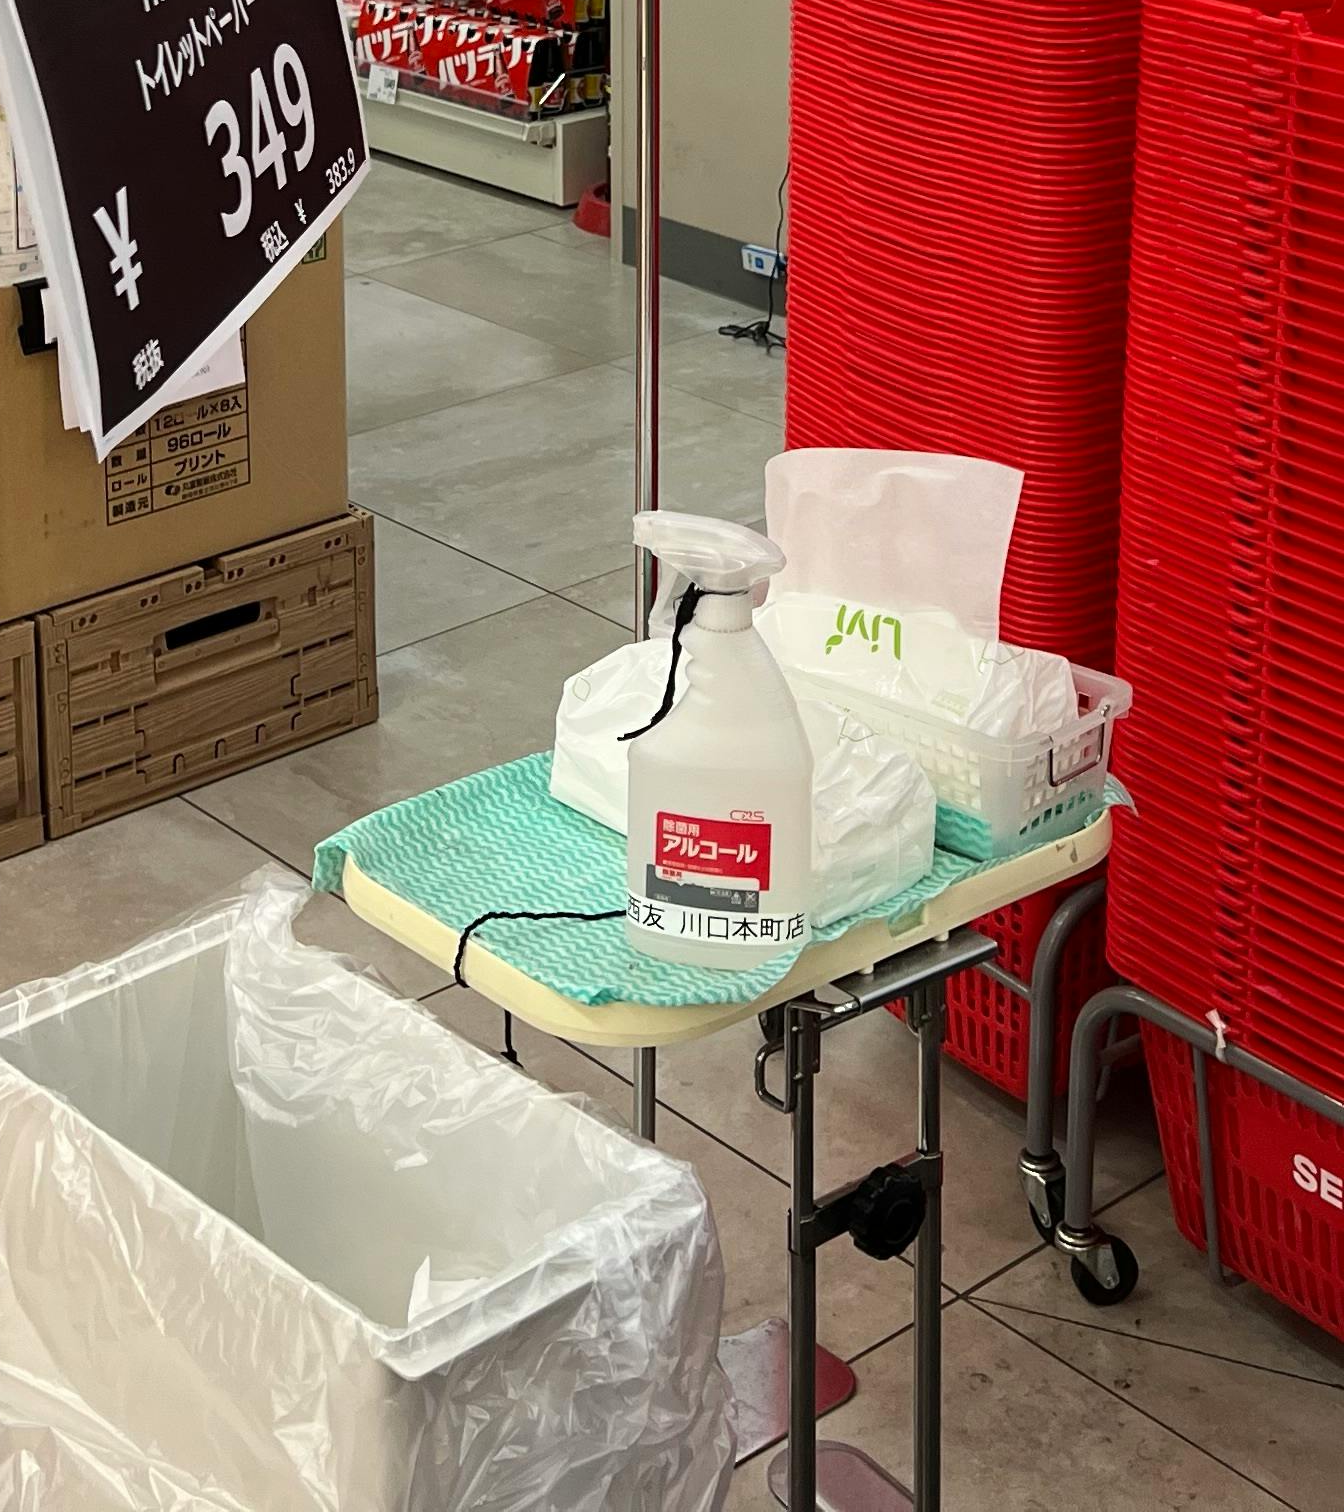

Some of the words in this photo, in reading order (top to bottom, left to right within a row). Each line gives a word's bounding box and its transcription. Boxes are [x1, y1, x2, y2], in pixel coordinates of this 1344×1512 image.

[93, 186, 143, 310] ¥
[206, 43, 314, 237] 349
[260, 213, 290, 262] 税込
[324, 148, 356, 196] 383.9
[131, 338, 164, 390] 税抜
[167, 422, 232, 453] 96ロール
[174, 449, 226, 476] プリント
[112, 473, 148, 492] ロール
[112, 496, 149, 518] 製造元
[662, 818, 701, 838] 除菌用
[662, 833, 758, 864] アルコール
[628, 892, 665, 930] 西友
[680, 910, 805, 941] 川口本町店
